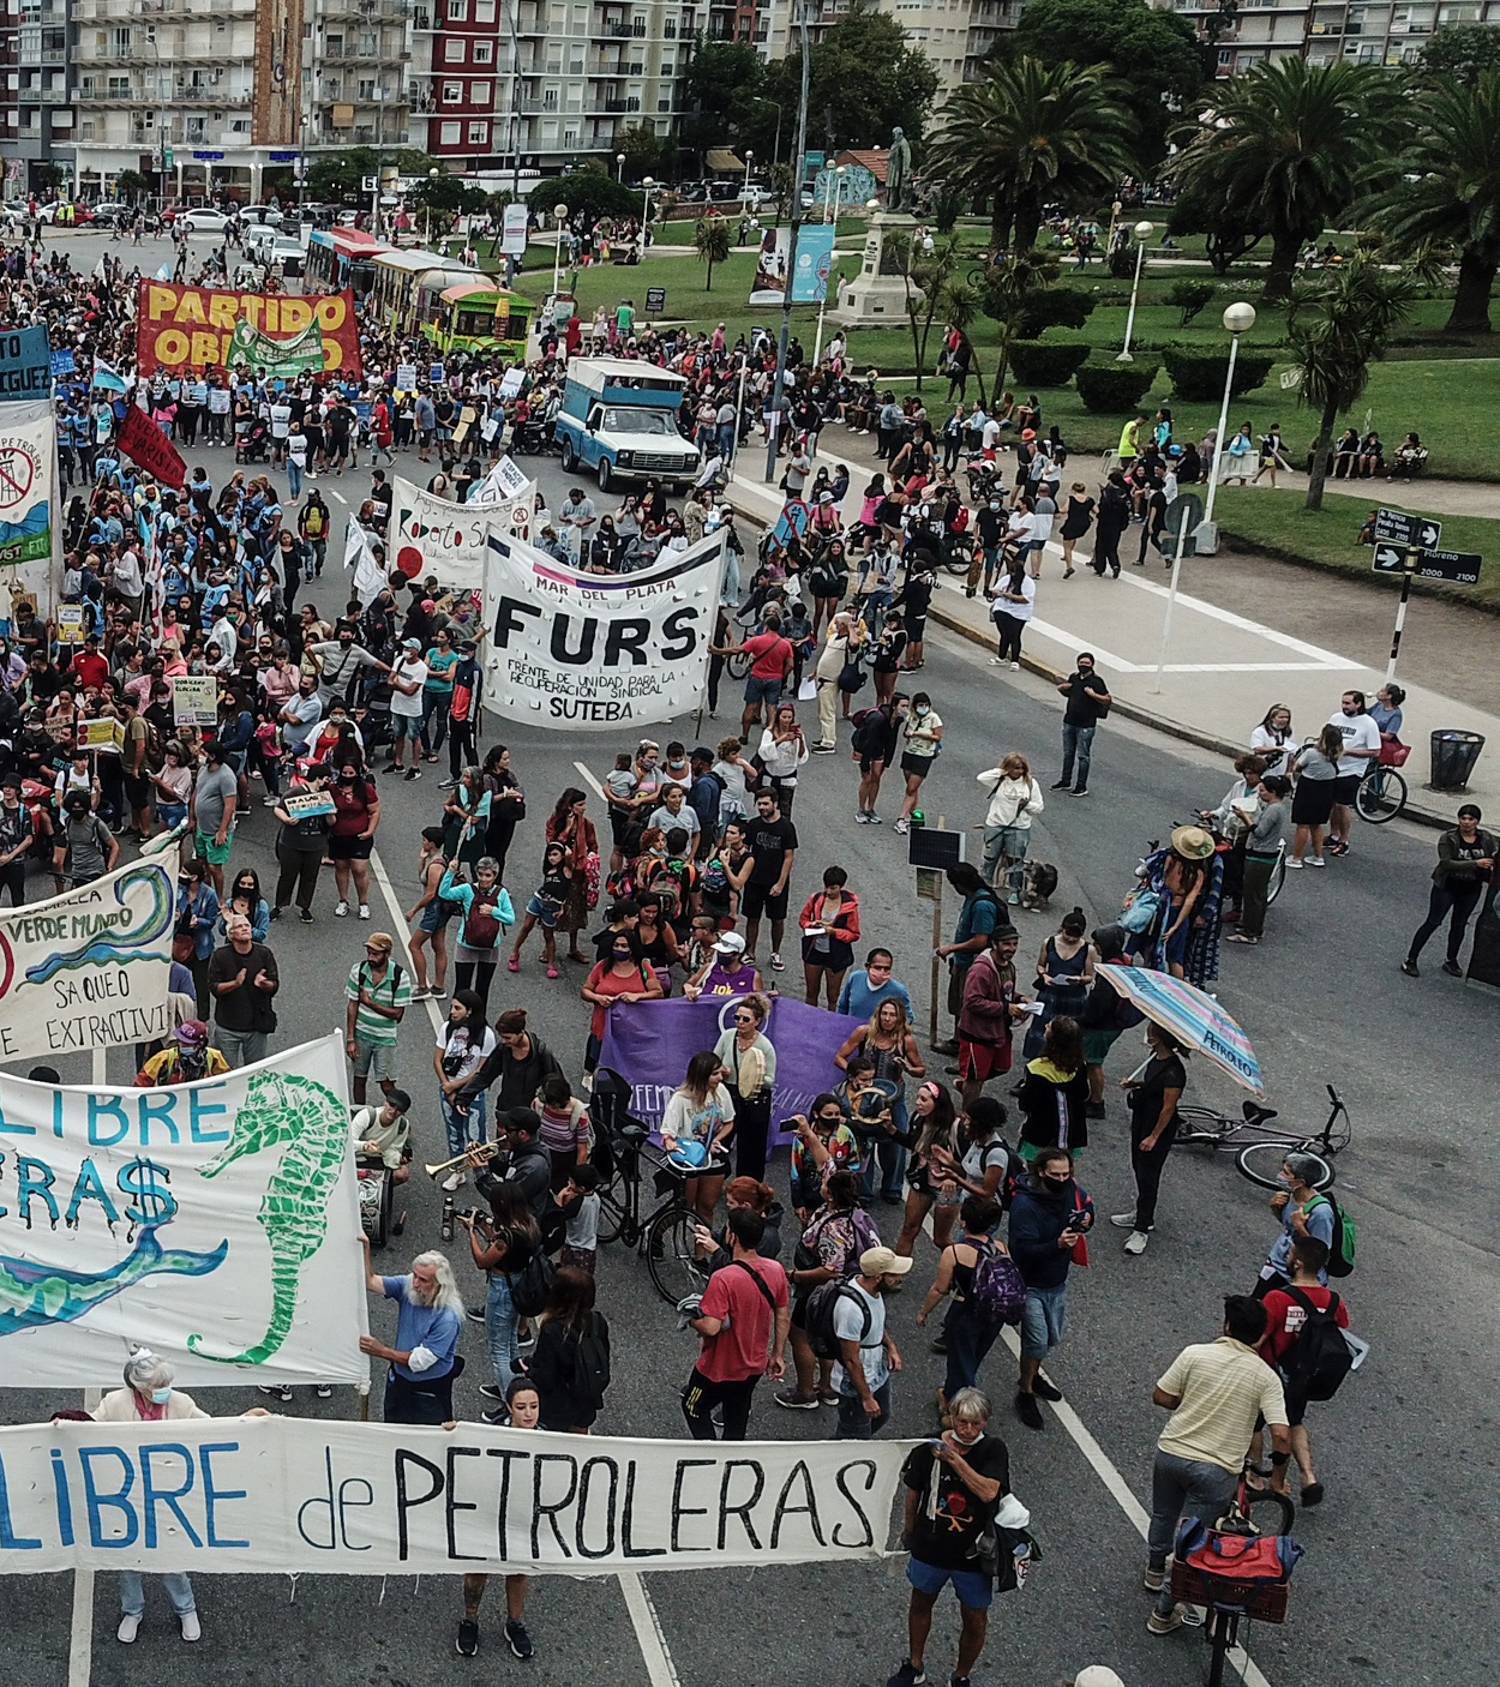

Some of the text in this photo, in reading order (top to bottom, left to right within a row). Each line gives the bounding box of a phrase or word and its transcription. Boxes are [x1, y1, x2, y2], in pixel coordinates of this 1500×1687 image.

[149, 285, 347, 332] PARTIDO
[155, 329, 343, 371] OBO
[1, 437, 44, 500] PETROLERAS
[398, 509, 463, 550] Roberto
[1424, 551, 1459, 561] Moreno
[536, 575, 676, 601] MAR DEL PLATA
[1421, 568, 1477, 582] 2000 2100
[494, 595, 700, 667] FURS
[508, 659, 676, 689] FRENTE DE UNIDAD PARA LA
[610, 684, 663, 699] SINDICAL
[549, 695, 633, 722] SUTEBA
[9, 908, 133, 943] VERDE MUNDO
[297, 1445, 375, 1551] de
[395, 1447, 878, 1561] PETROLERAS
